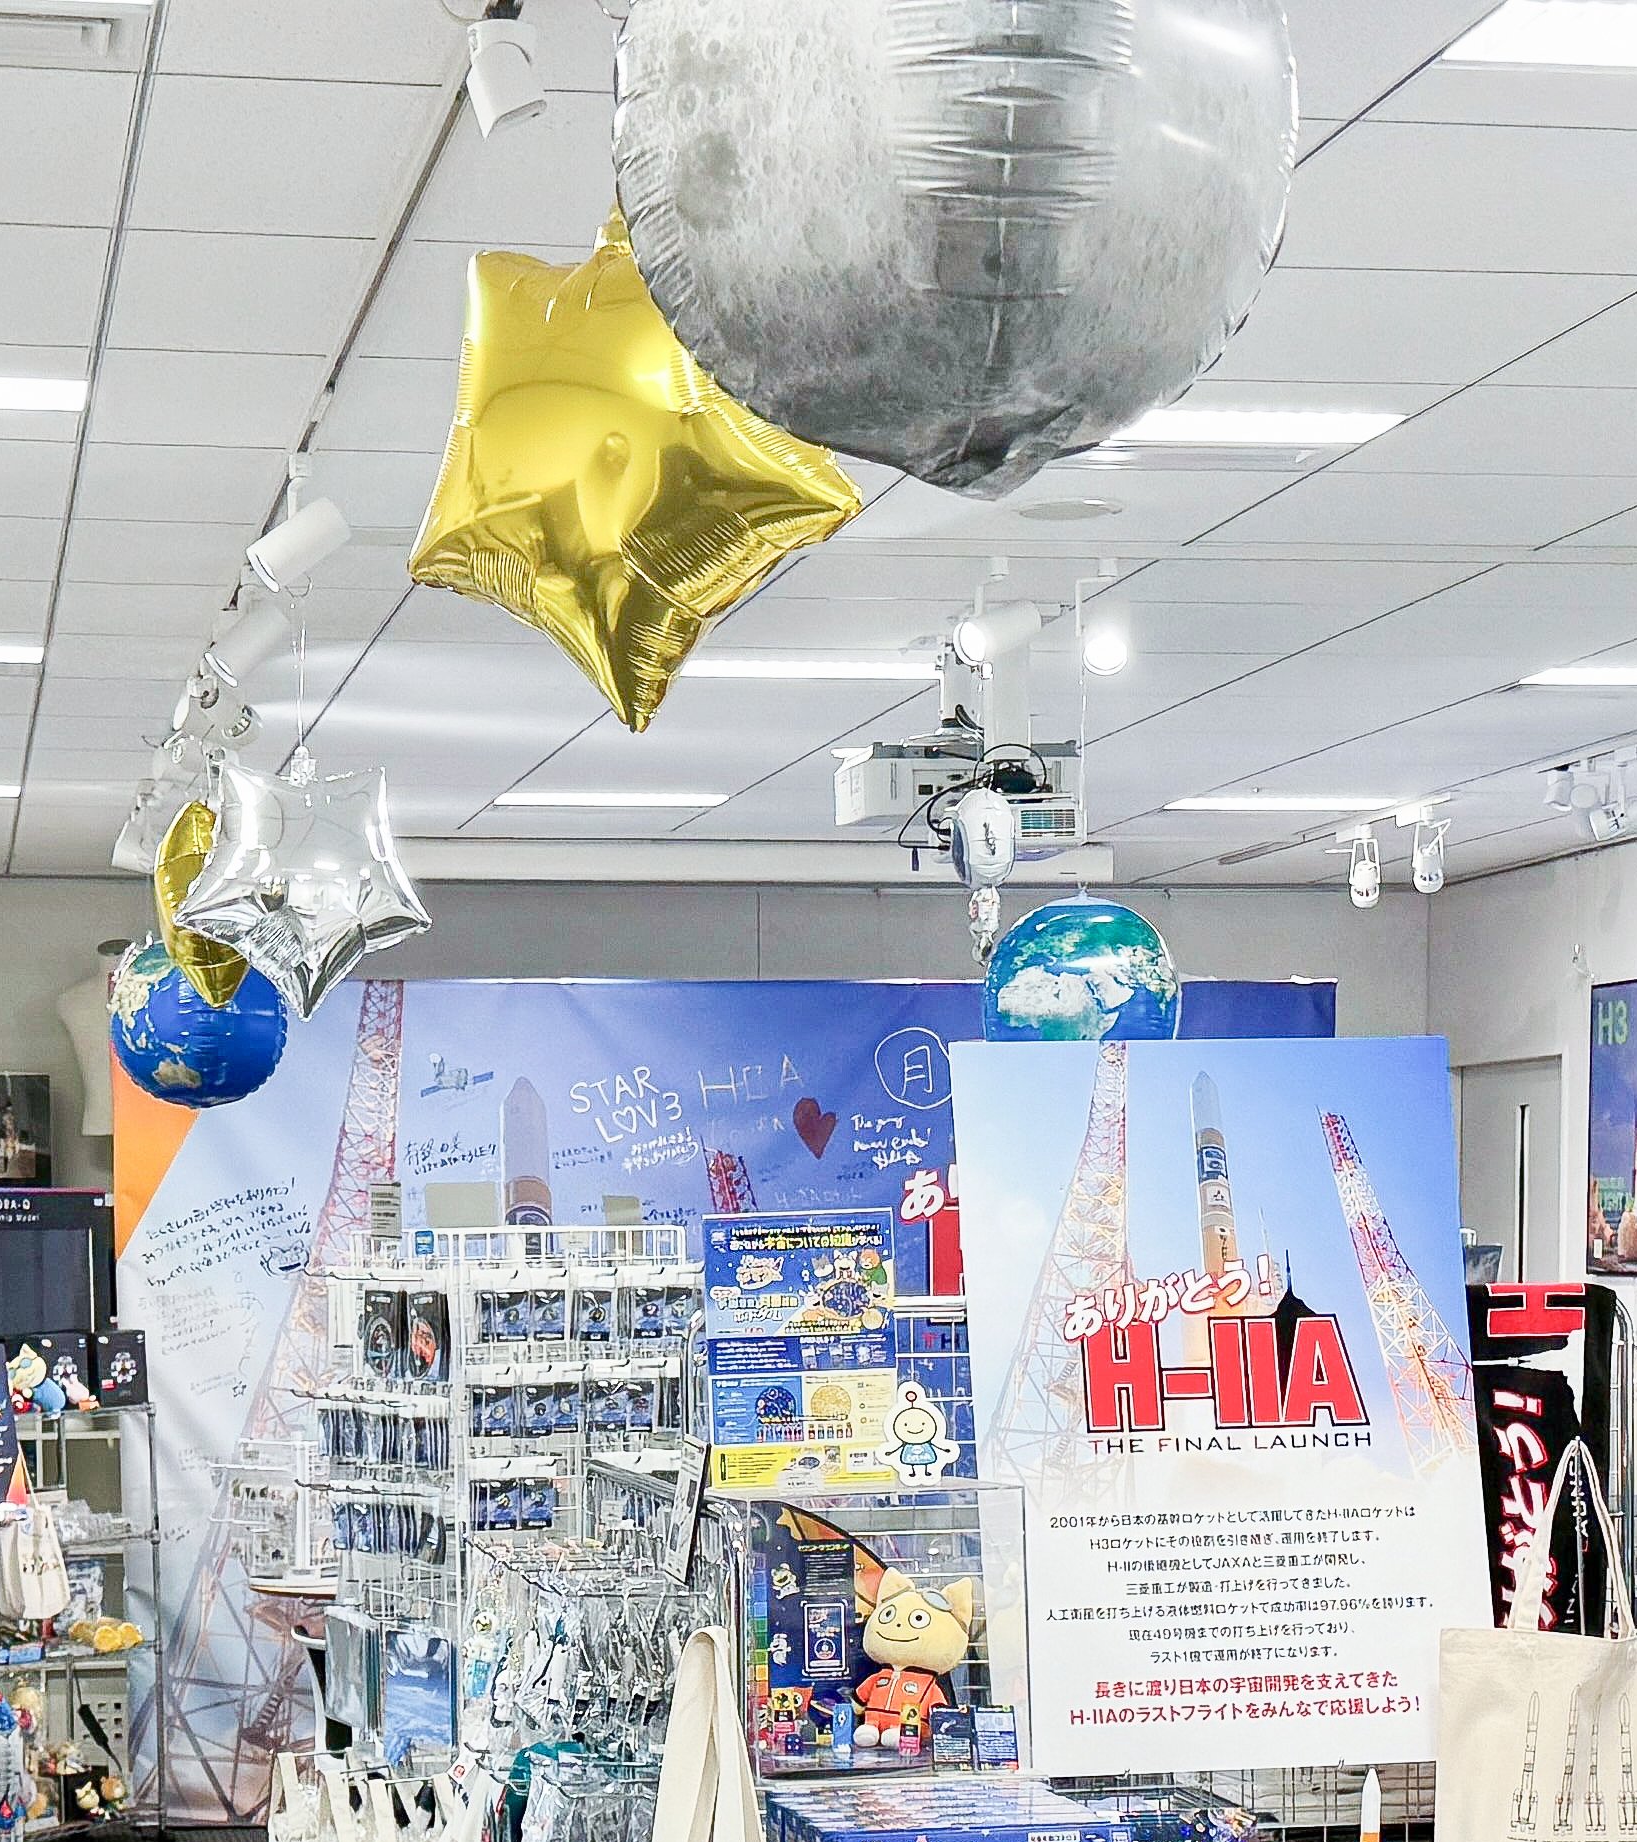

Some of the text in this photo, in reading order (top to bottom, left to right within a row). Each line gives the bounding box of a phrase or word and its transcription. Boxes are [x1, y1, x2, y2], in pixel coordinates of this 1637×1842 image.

[1597, 1001, 1628, 1045] H3
[569, 1066, 660, 1114] STAR
[1064, 1253, 1273, 1341] ありがとう！
[1082, 1314, 1370, 1433] H-IIA
[1088, 1432, 1372, 1455] THE FINAL LAUNCH
[1094, 1671, 1399, 1699] 長きに渡り日本の宇宙開発を支えてきた
[1070, 1695, 1421, 1726] H-IIAのラストフライトをみんなで応援しよう！
